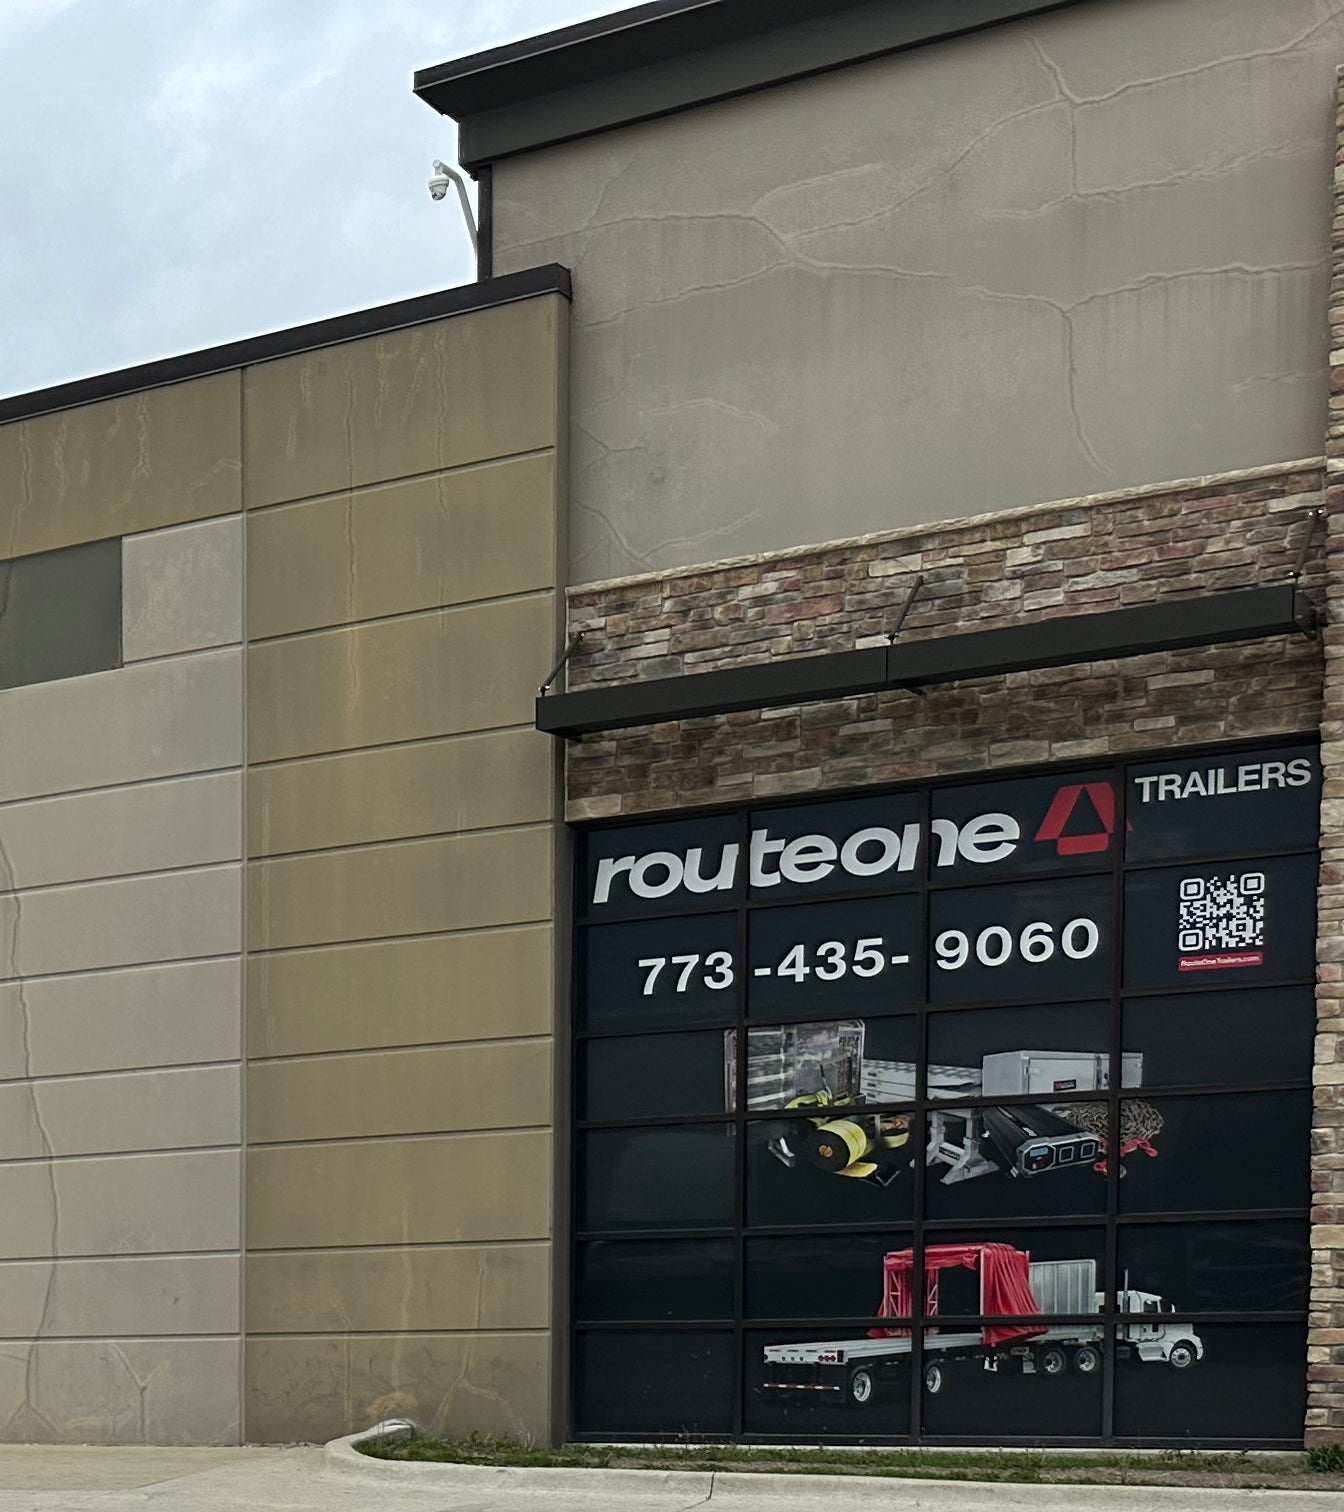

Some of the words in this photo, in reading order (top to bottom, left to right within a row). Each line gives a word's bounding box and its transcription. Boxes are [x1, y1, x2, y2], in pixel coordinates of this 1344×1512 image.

[1134, 757, 1312, 803] TRAILERS
[592, 811, 1021, 905] routeone
[934, 917, 1101, 971] 9060
